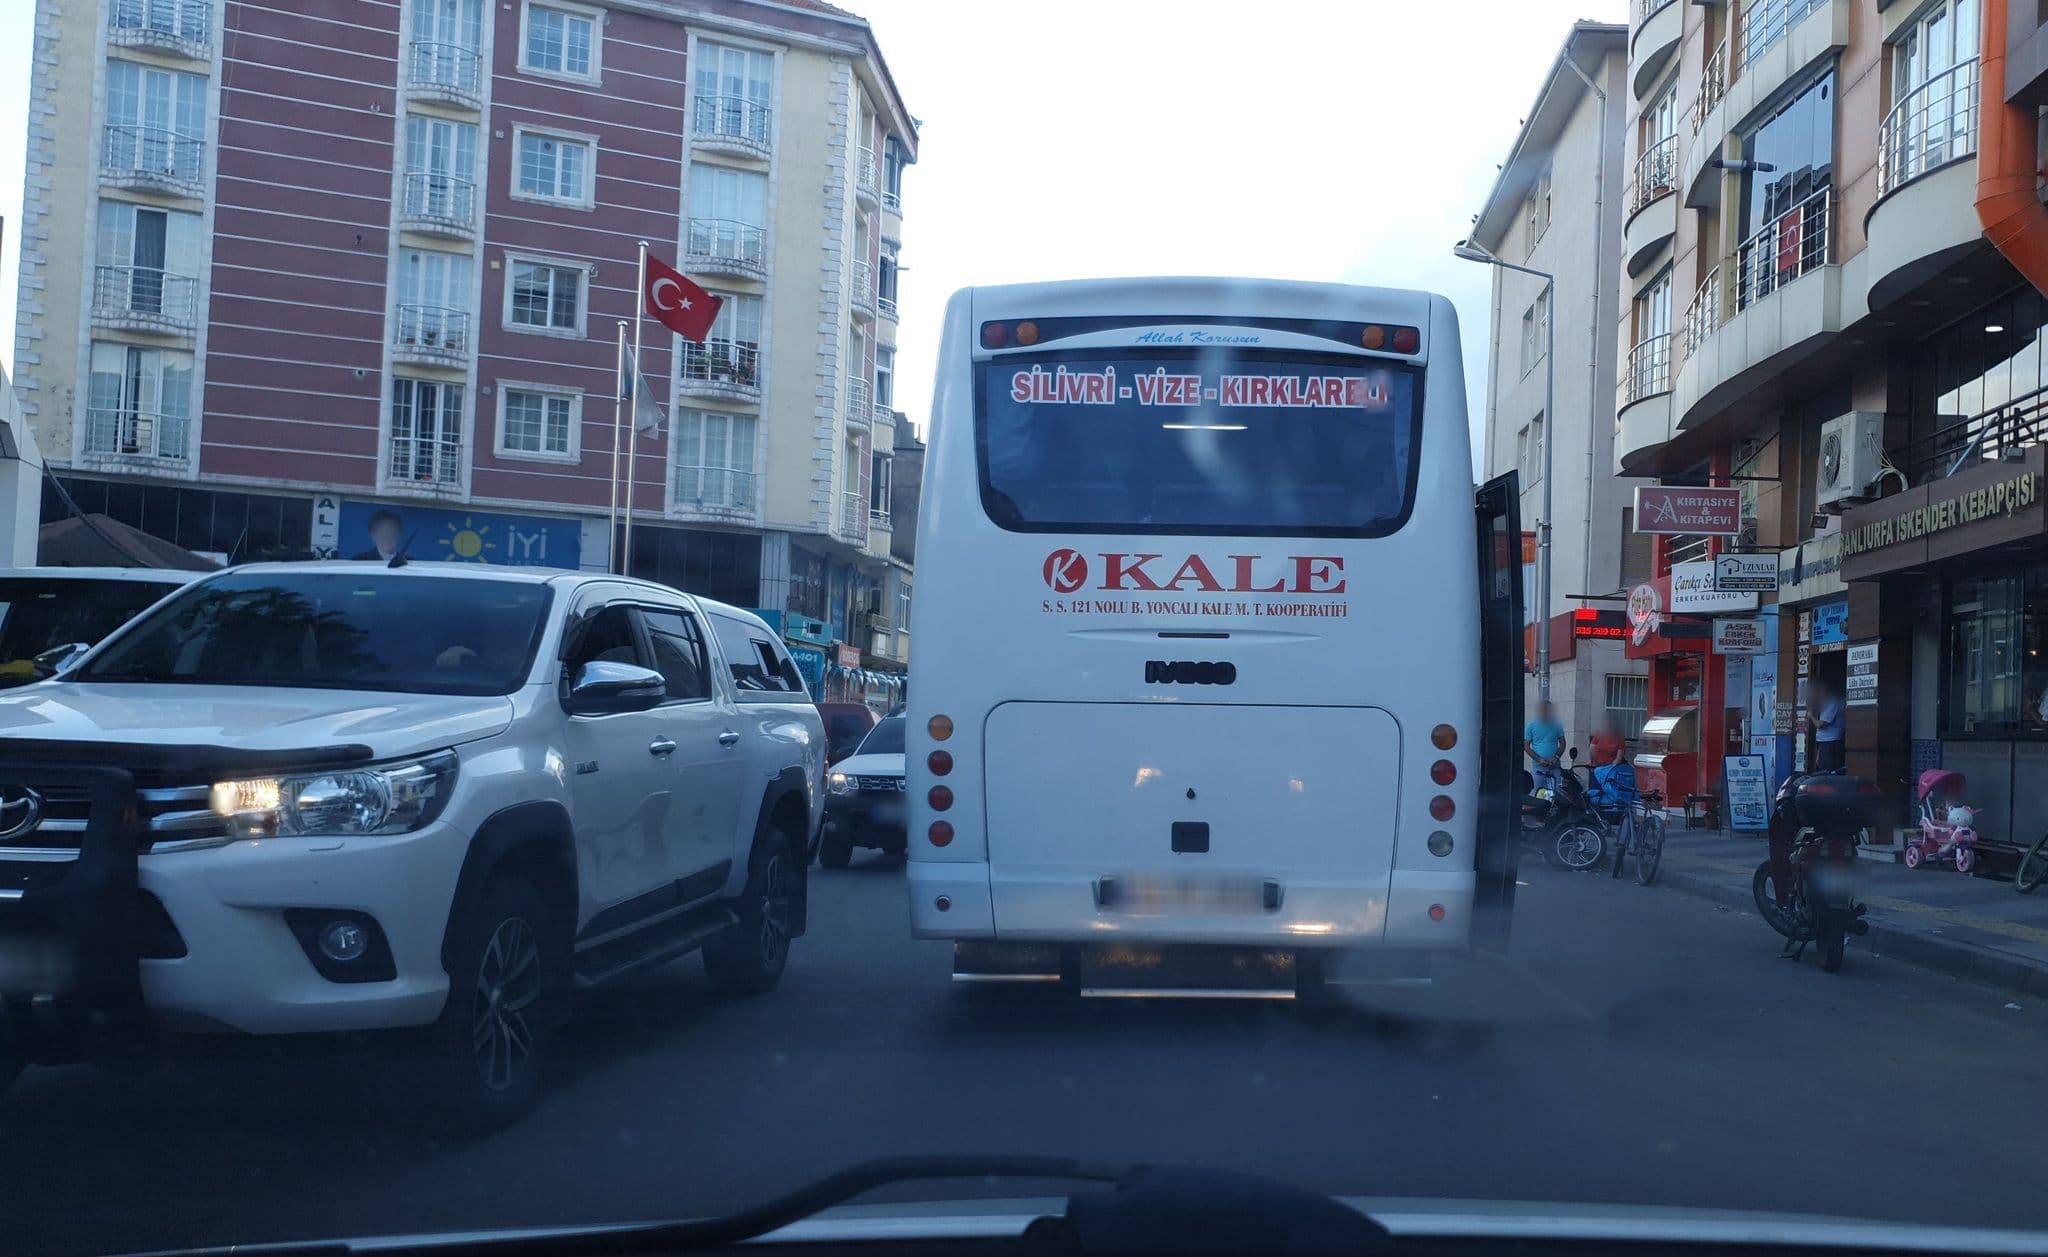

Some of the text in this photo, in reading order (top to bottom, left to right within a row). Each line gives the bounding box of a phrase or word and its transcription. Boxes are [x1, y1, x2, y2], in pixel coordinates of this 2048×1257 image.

[1135, 331, 1261, 344] Allah Korusun
[1011, 364, 1116, 404] SİLİVRİ
[1135, 367, 1201, 405] VİZE
[1959, 471, 2036, 524] KEBAPÇISI
[1701, 507, 1712, 515] &
[1097, 553, 1346, 594] KALE
[1675, 595, 1699, 603] ERKEK
[1042, 600, 1348, 618] S. S. 121 NOLU B. YONCALI KALE M. T. KOOPERATİFİ
